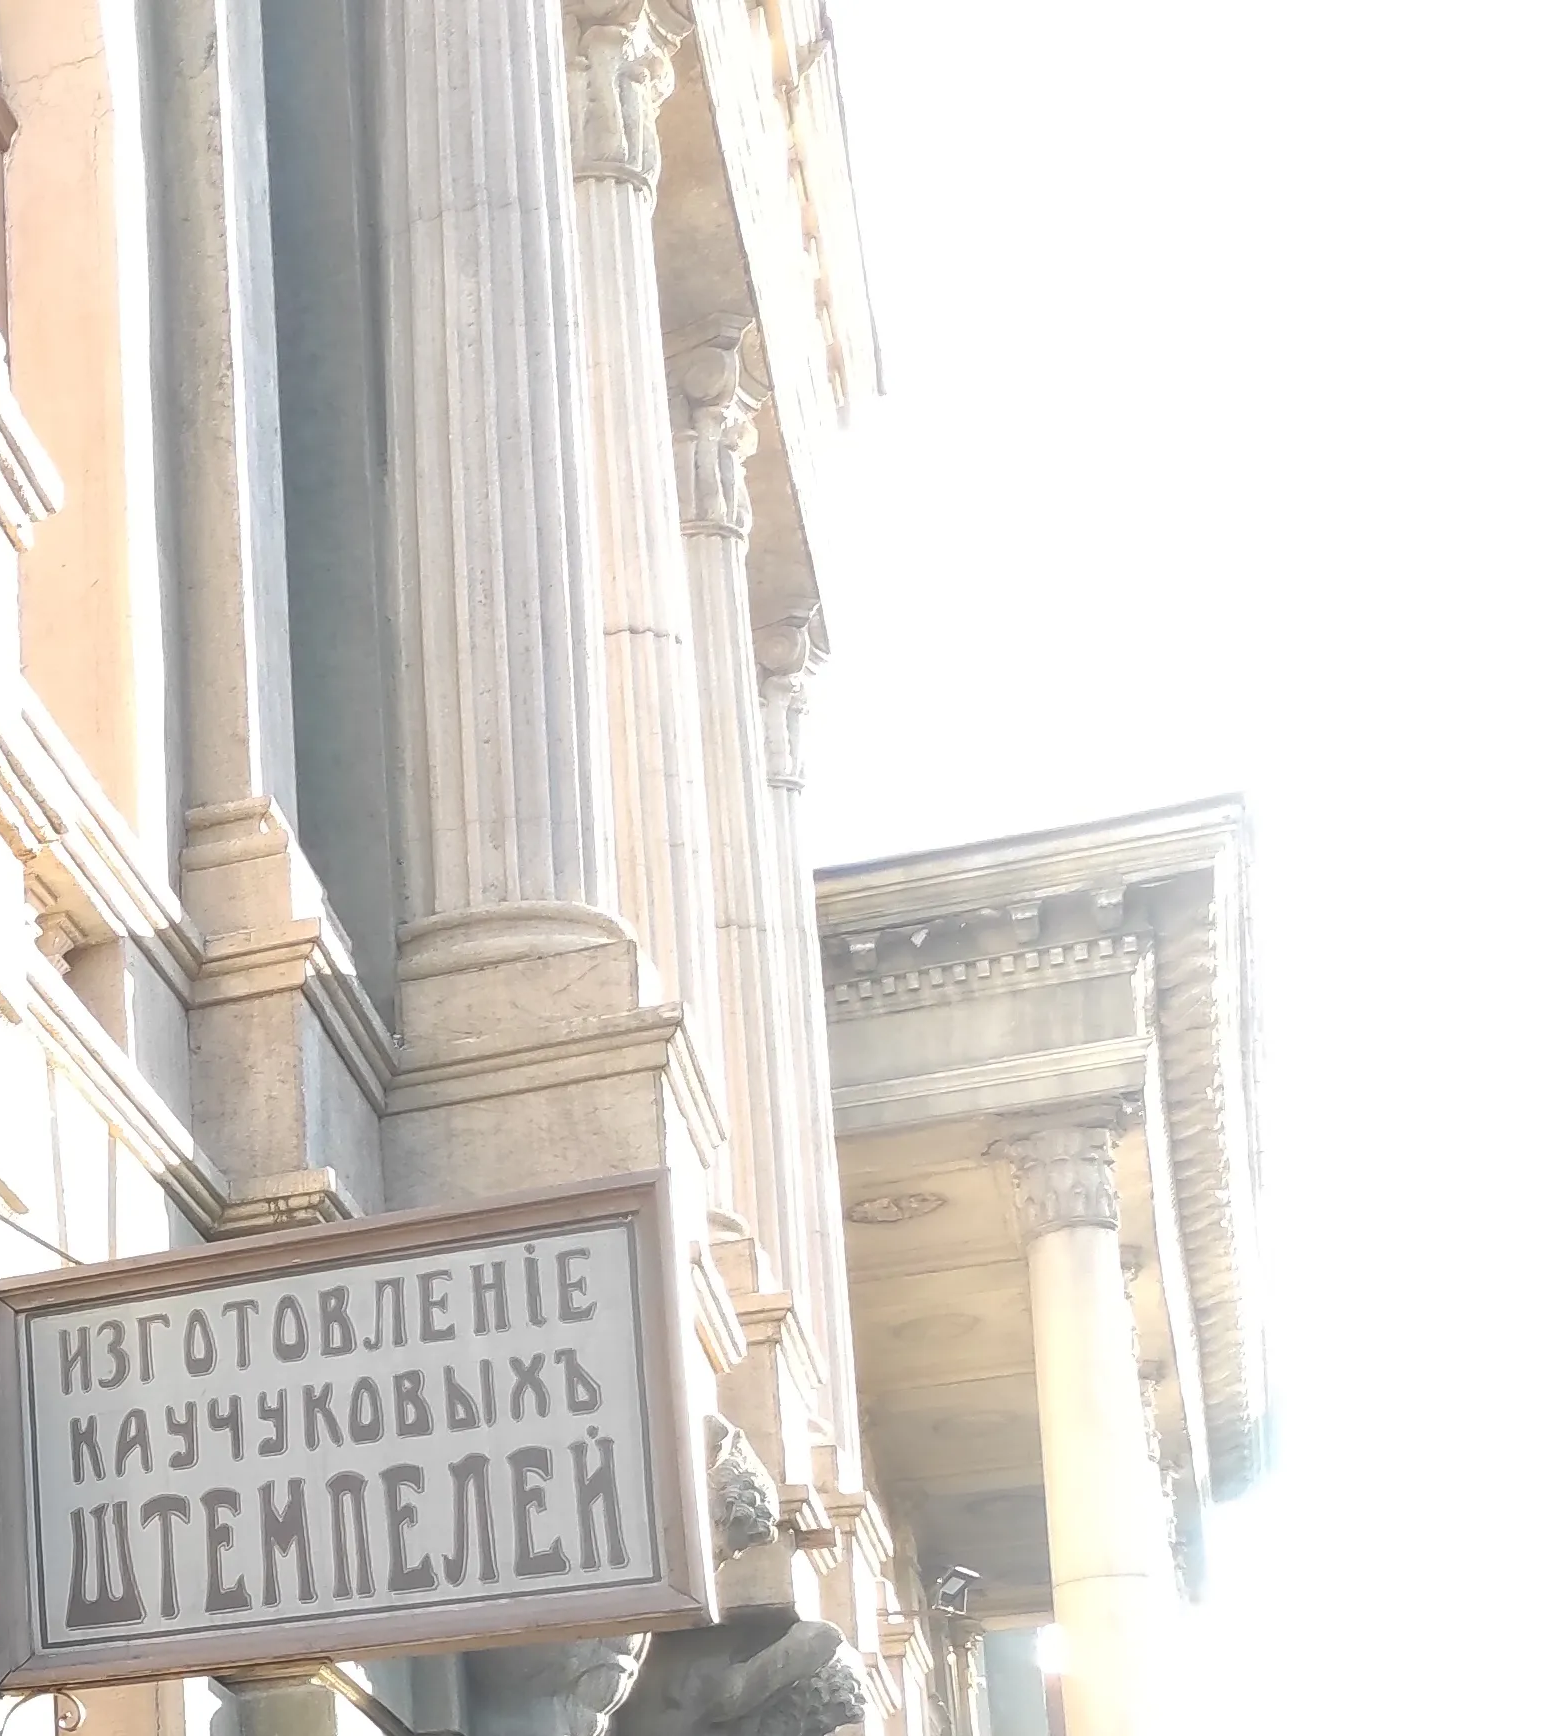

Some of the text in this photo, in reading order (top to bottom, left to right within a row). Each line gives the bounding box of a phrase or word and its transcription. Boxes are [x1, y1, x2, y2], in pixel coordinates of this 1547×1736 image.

[57, 1242, 599, 1396] ИЗГОТОВЛЕНІЕ
[69, 1347, 603, 1485] КАУЧУКОВЫХЪ
[65, 1424, 629, 1631] ШТЕМПЕЛЕЙ
